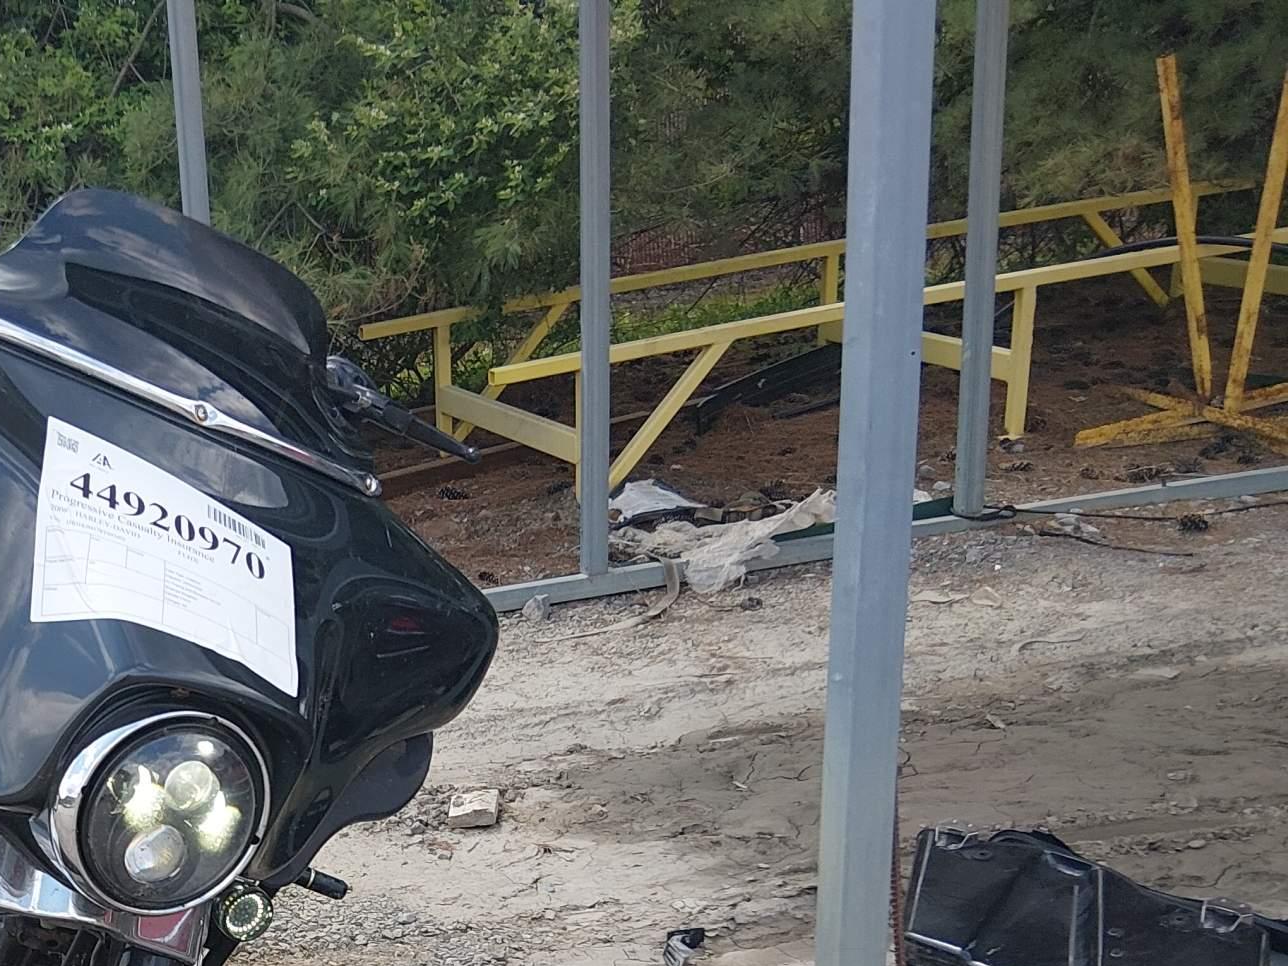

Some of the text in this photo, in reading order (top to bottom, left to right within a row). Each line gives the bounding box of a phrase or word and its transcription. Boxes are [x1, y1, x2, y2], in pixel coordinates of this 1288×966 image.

[51, 487, 115, 520] Progressive
[117, 515, 162, 540] Casualty
[167, 534, 216, 563] Insurance
[70, 472, 266, 580] 44920970
